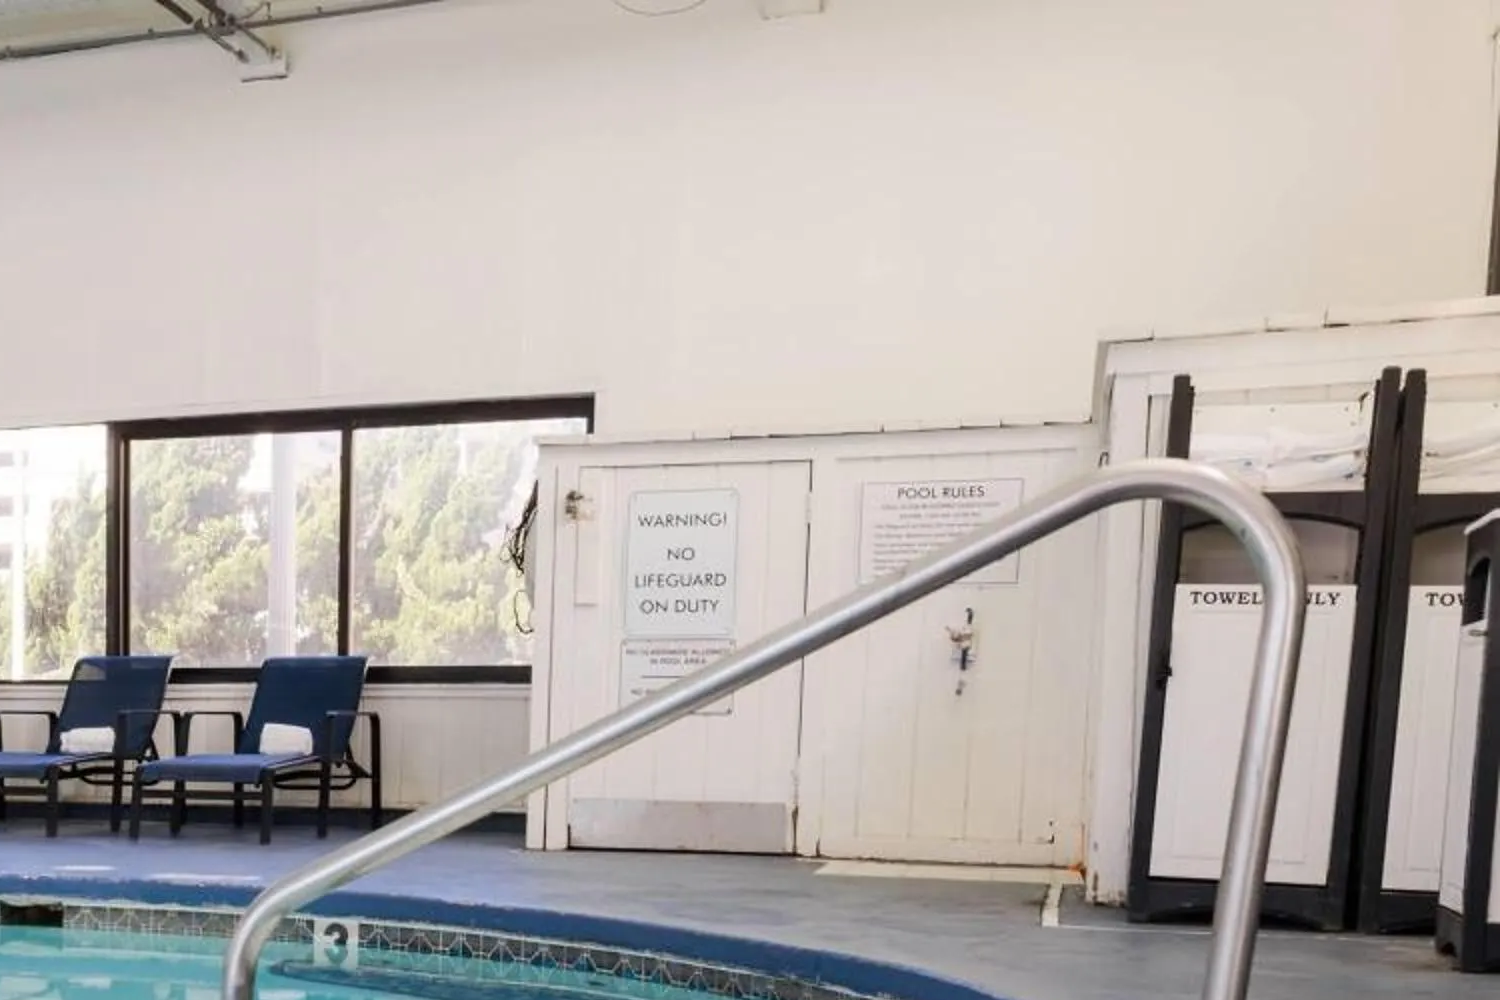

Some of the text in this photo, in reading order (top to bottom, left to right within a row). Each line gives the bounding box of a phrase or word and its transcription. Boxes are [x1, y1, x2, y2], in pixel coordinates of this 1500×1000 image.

[897, 485, 986, 500] POOL RULES
[638, 511, 728, 528] WARNING!
[666, 546, 696, 561] NO
[634, 573, 727, 588] LIFEGUARD
[1189, 591, 1265, 606] TOWEL
[640, 599, 721, 614] ON DUTY
